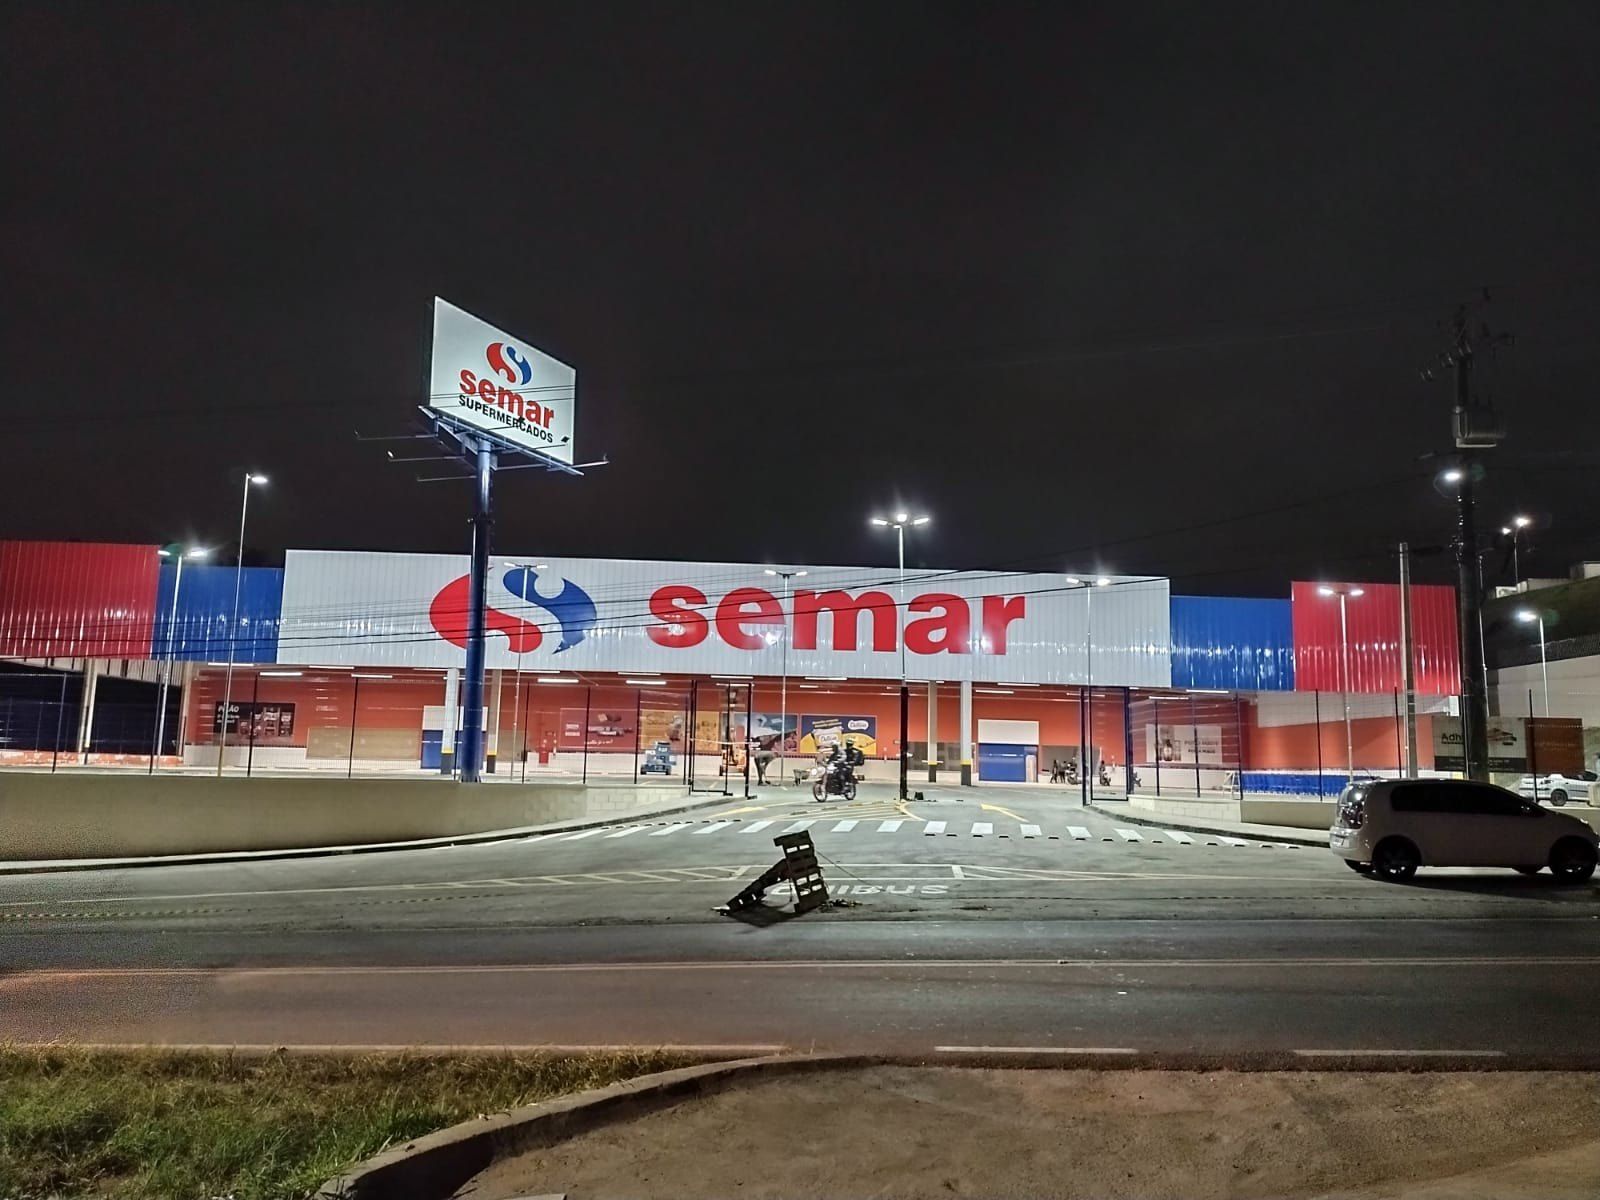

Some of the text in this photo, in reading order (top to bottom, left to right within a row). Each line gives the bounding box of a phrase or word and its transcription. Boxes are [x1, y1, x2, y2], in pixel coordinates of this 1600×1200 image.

[458, 394, 553, 443] SUPERMERCADOS
[459, 369, 554, 429] semar
[646, 585, 1025, 655] semar
